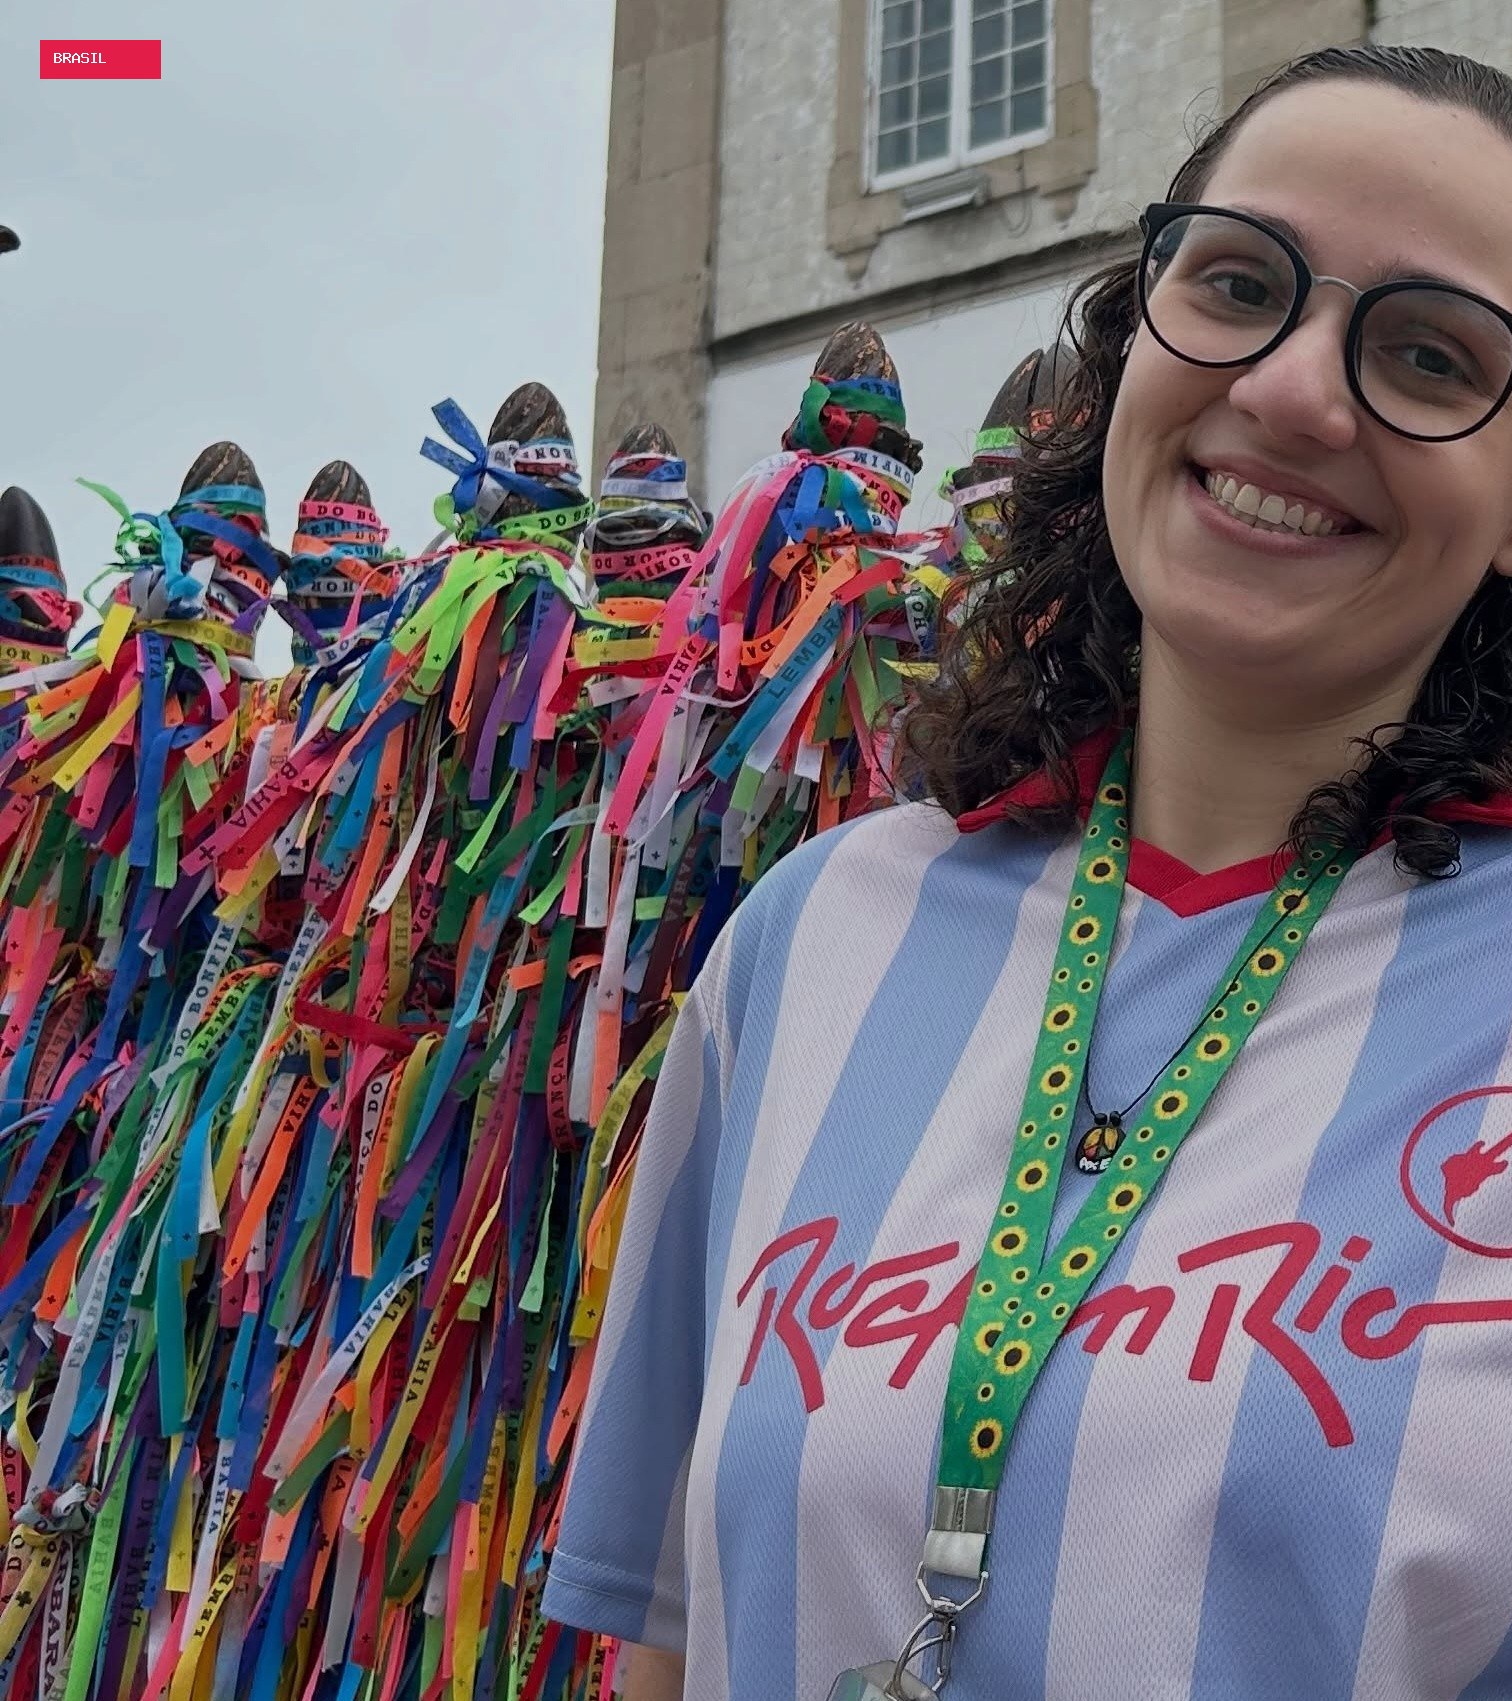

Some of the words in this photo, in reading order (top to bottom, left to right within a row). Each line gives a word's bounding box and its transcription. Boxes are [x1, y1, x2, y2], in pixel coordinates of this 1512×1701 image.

[316, 504, 345, 517] DO
[537, 512, 567, 529] DO
[660, 634, 698, 698] BAHIA
[229, 762, 298, 831] BAHIA
[175, 1026, 192, 1059] DO
[188, 924, 236, 1015] BONFIM
[366, 1081, 384, 1116] DO
[207, 1454, 232, 1536] BAHIA
